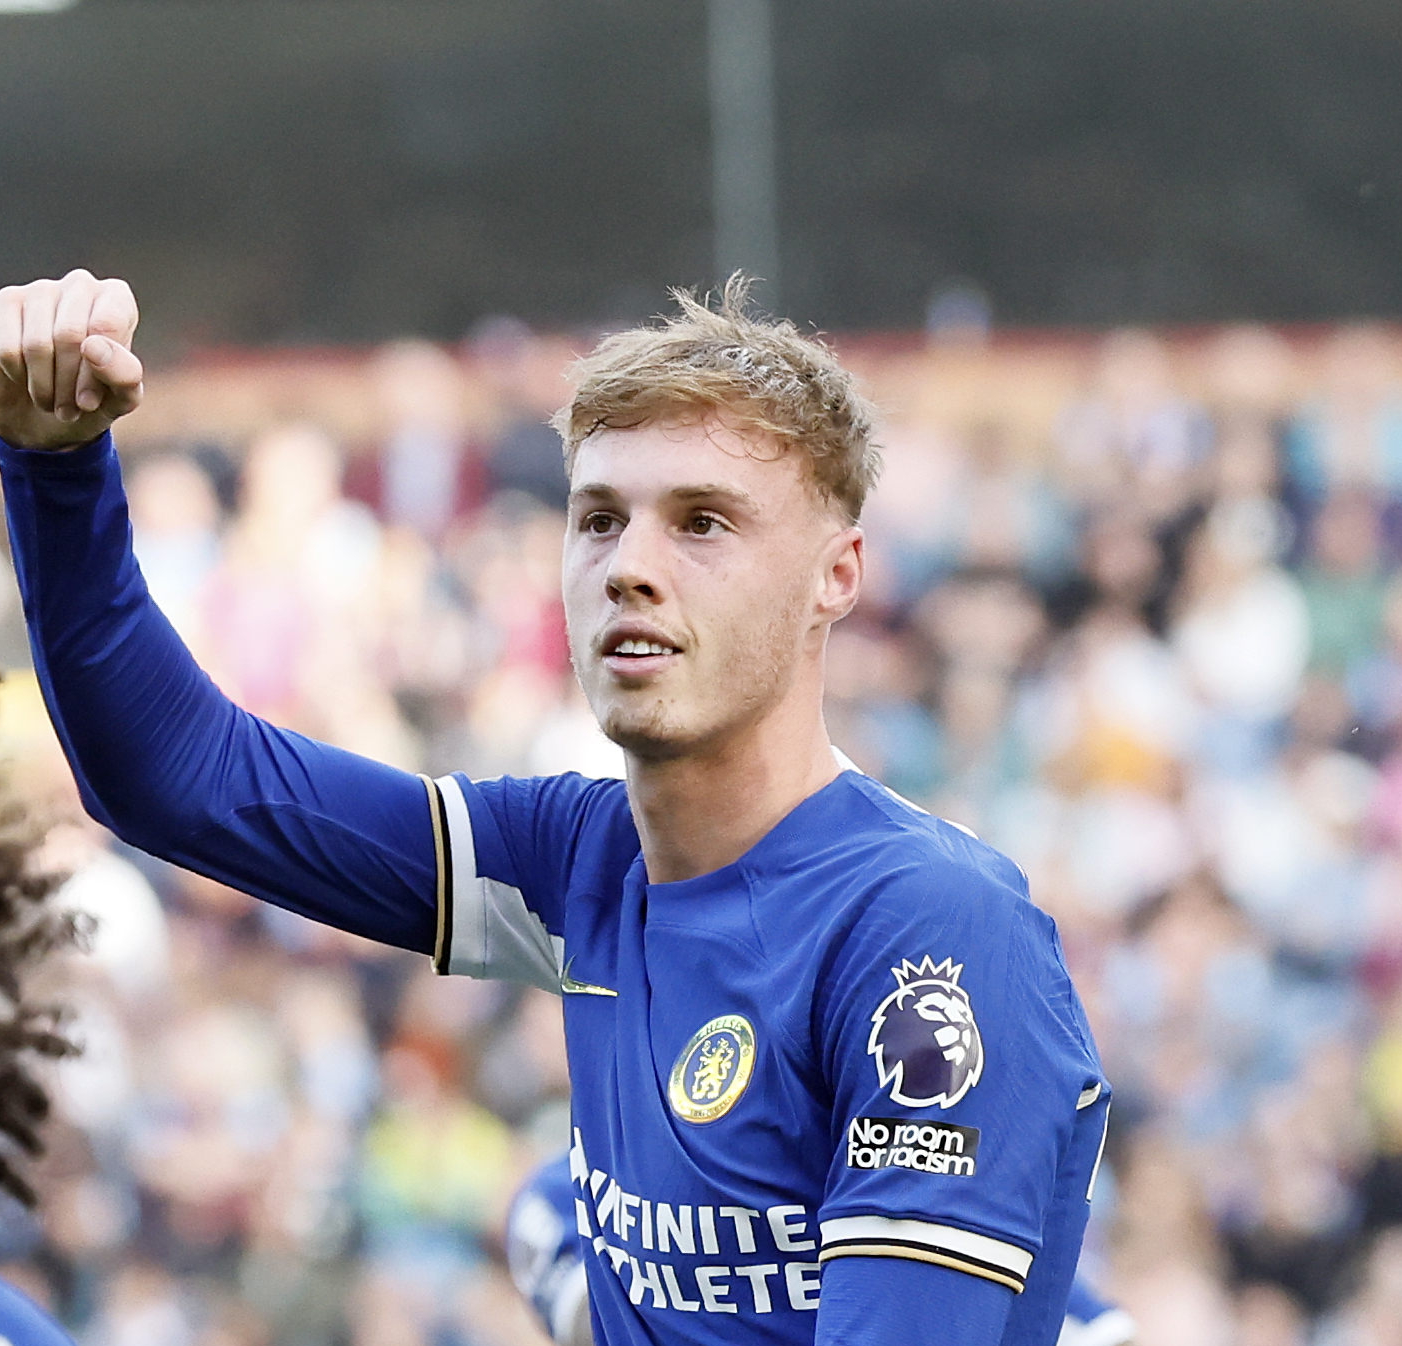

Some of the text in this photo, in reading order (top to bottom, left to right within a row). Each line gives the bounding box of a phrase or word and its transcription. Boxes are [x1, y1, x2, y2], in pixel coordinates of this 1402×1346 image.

[848, 1117, 965, 1154] No room
[847, 1141, 976, 1177] for racism
